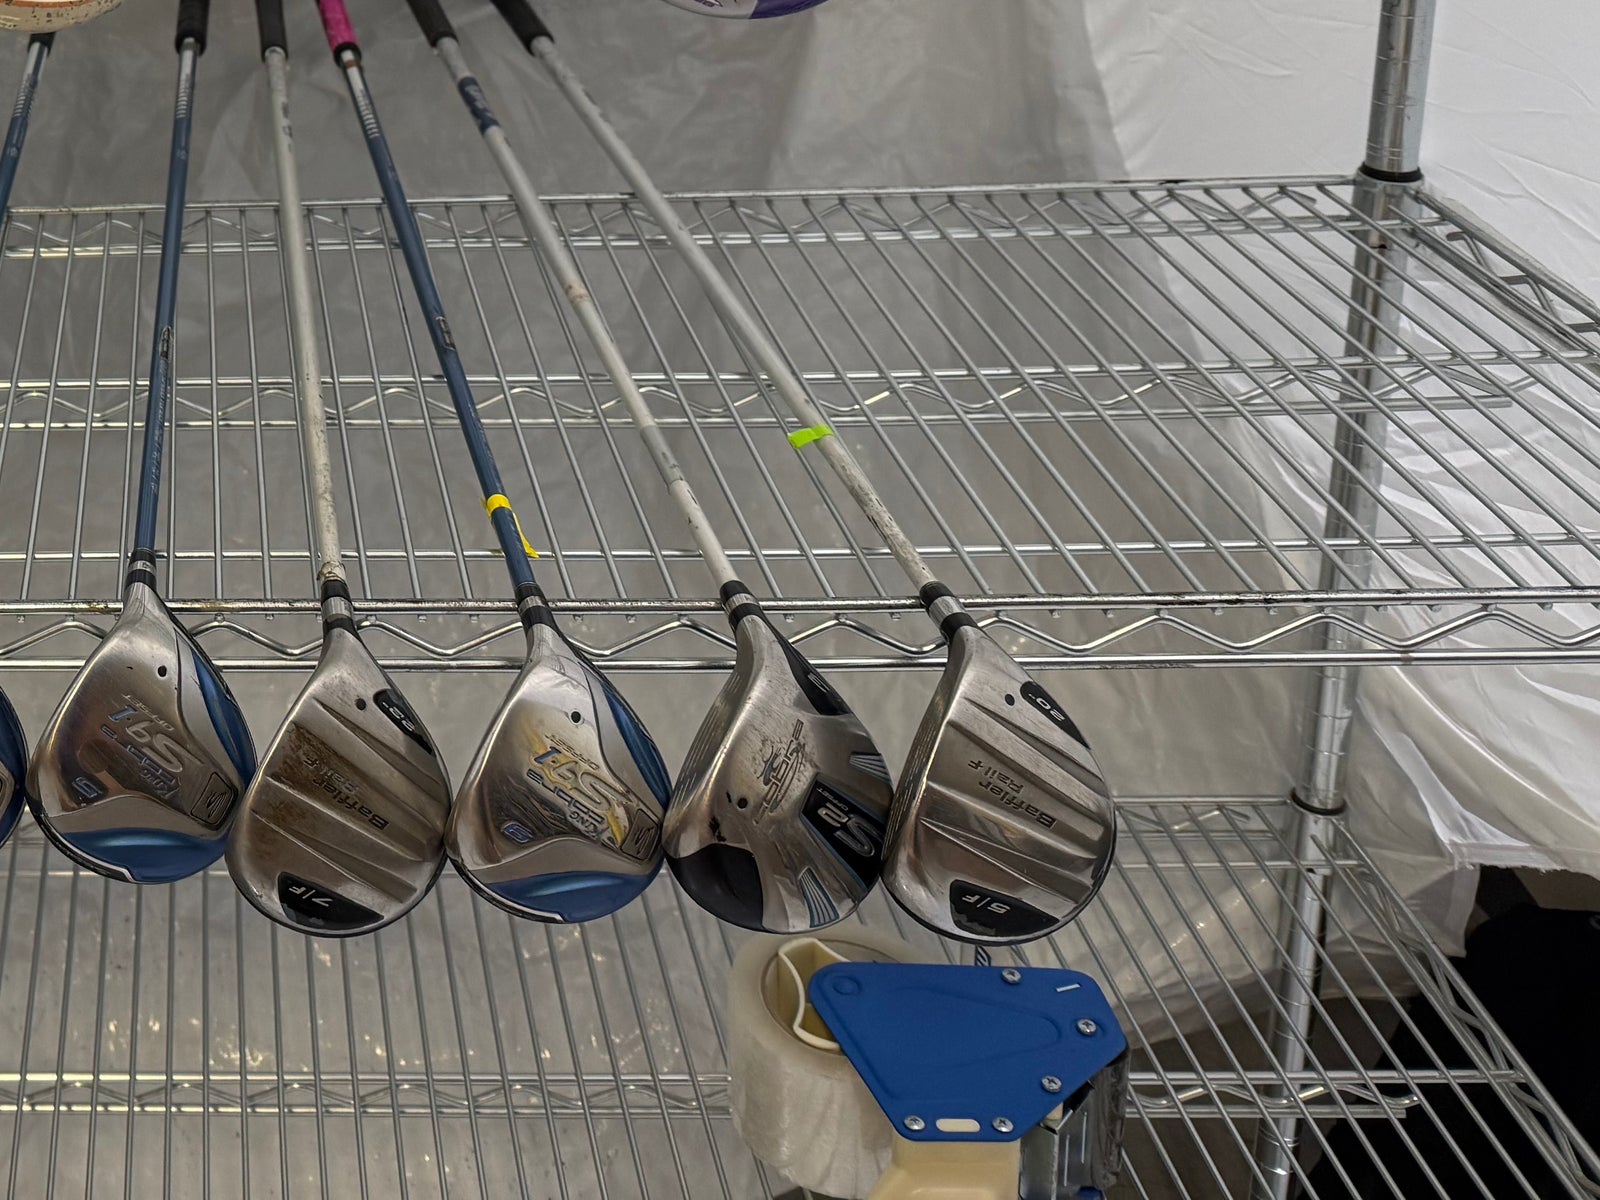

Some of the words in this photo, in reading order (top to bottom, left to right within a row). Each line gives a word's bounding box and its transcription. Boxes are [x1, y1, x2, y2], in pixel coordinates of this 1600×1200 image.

[72, 776, 103, 799] 5
[526, 768, 606, 824] cobra
[753, 718, 804, 825] cobra
[312, 778, 390, 831] Baffler
[816, 787, 848, 811] OFFSET
[978, 780, 1057, 829] Baffler
[817, 802, 883, 857] S2
[288, 886, 333, 907] 7/F
[962, 894, 1011, 915] 5/F
